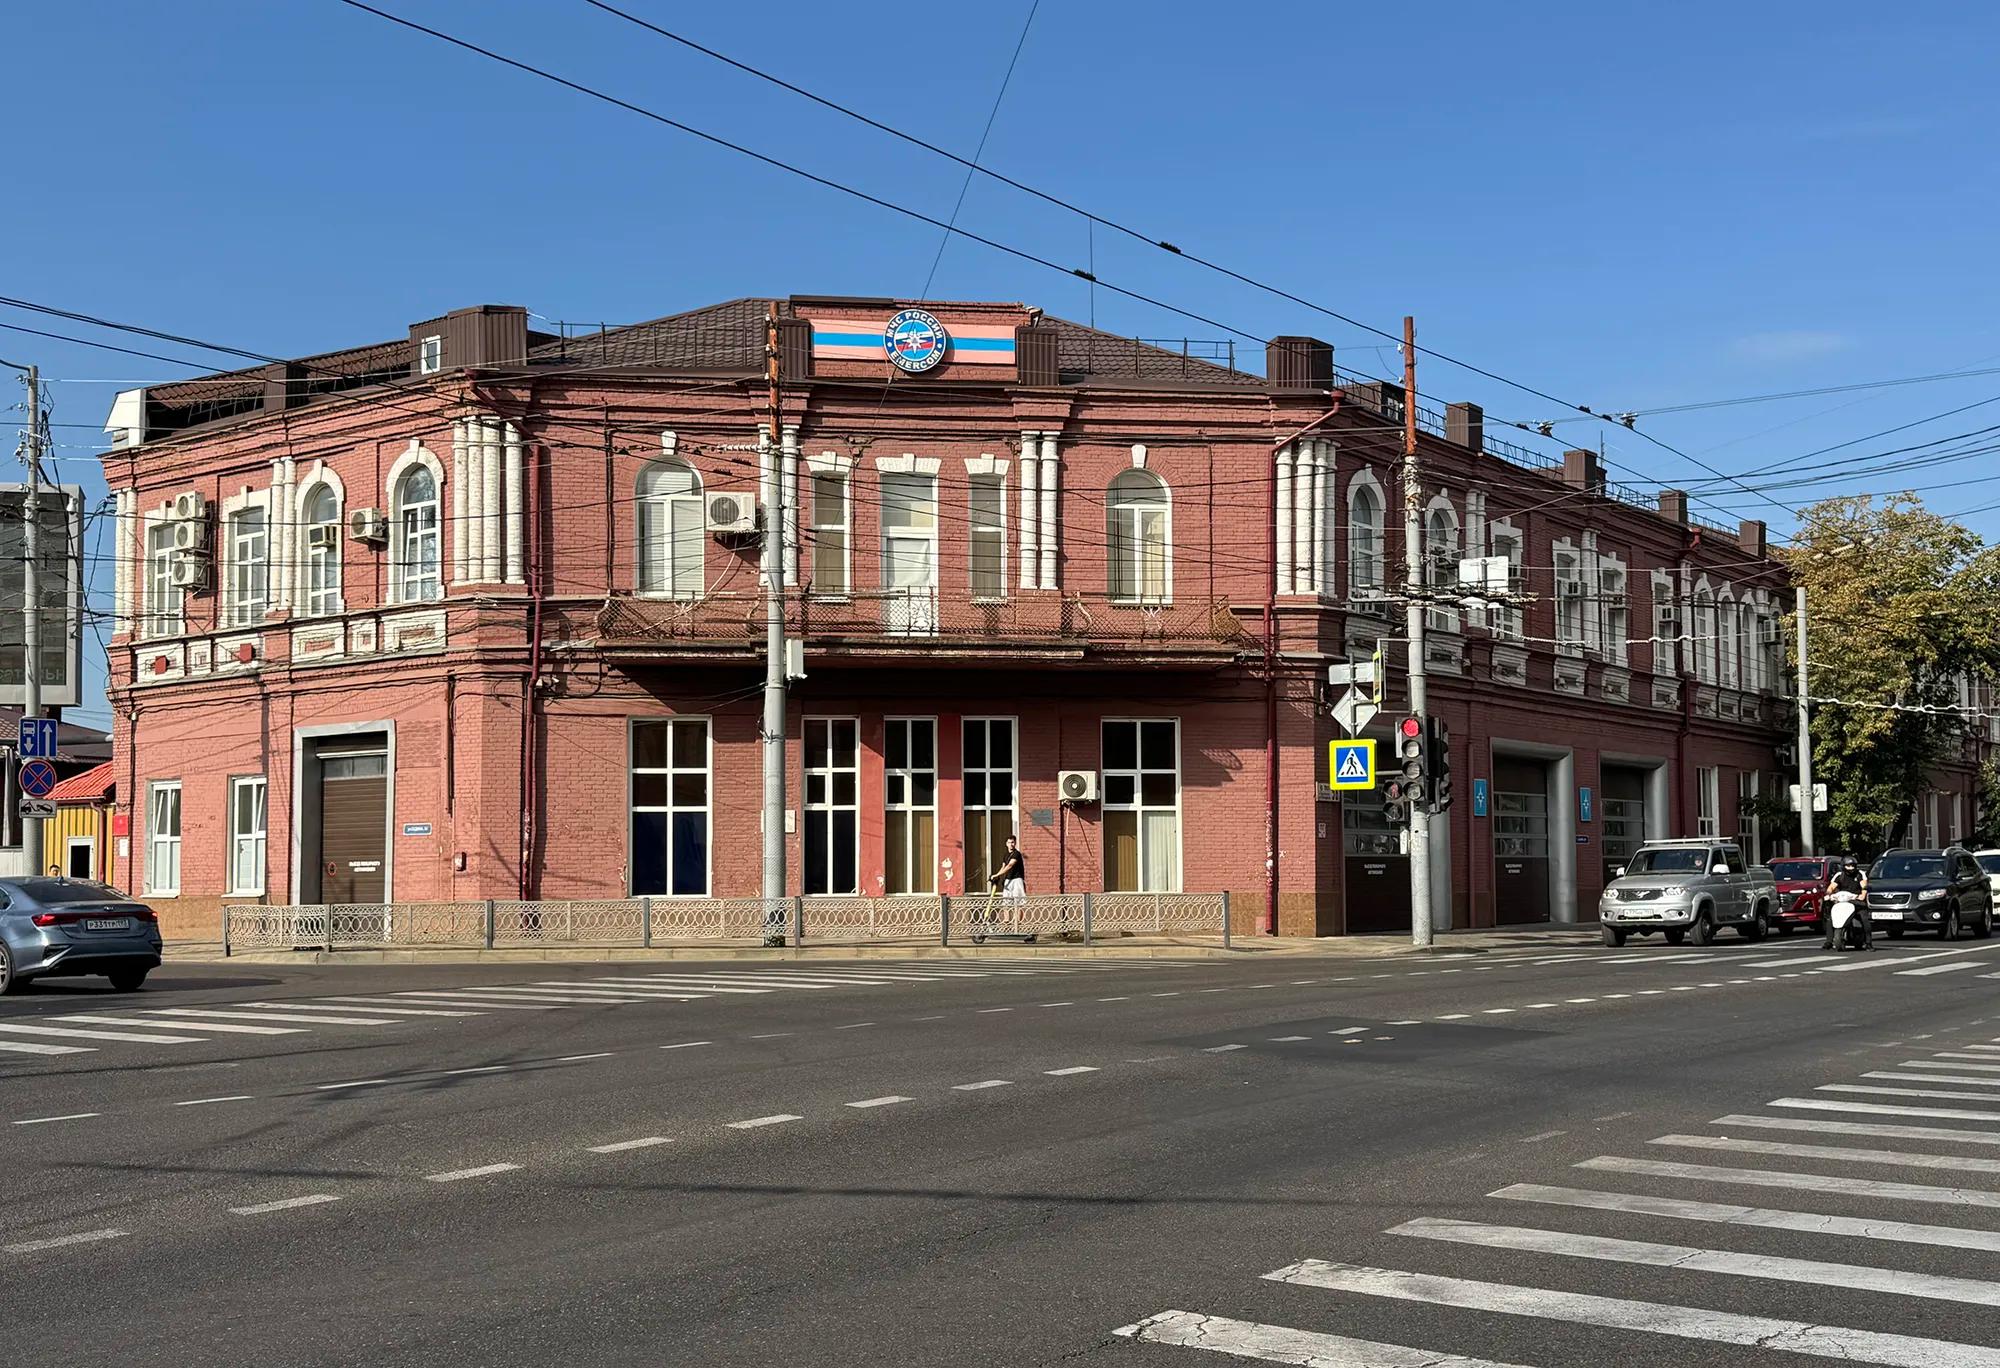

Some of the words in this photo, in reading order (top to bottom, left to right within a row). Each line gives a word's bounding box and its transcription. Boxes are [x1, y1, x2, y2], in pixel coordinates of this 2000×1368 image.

[886, 315, 904, 338] МЧС
[905, 311, 943, 339] РОССИИ
[890, 350, 941, 370] EMERCOM
